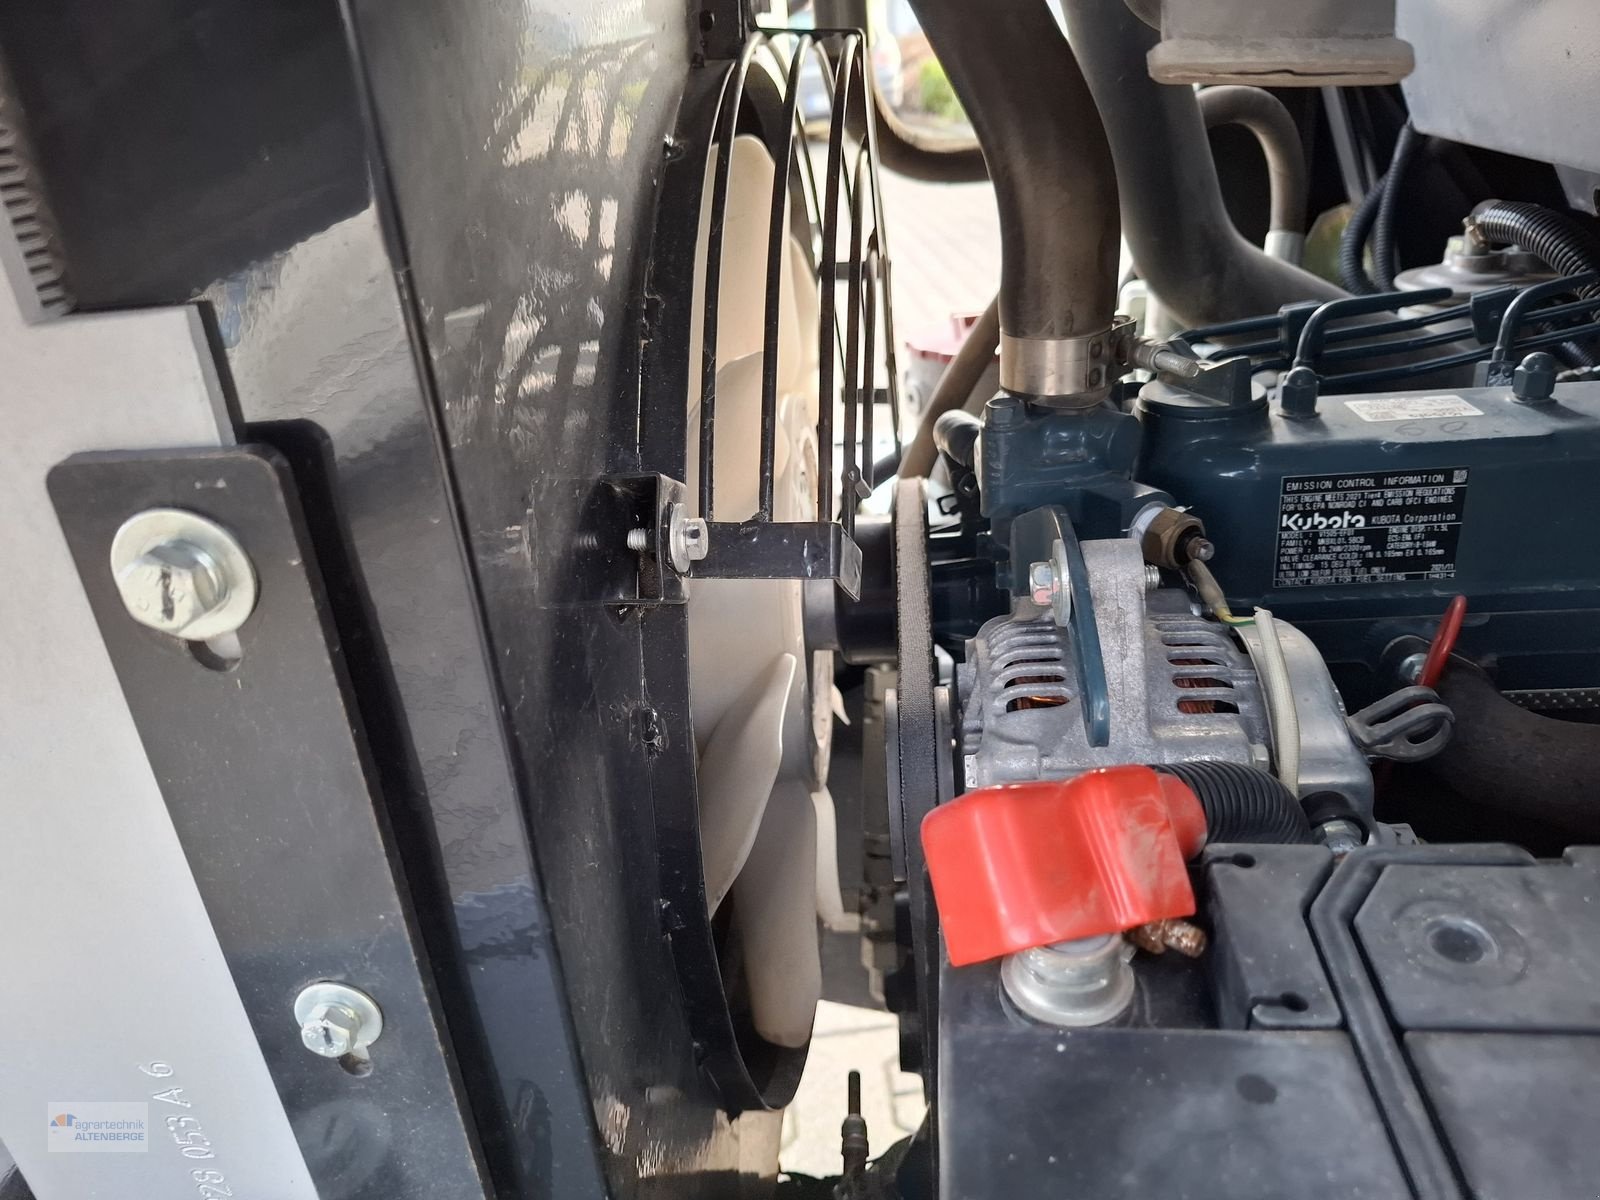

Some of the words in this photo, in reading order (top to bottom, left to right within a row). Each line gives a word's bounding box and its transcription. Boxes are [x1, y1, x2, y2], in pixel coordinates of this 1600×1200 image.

[1286, 480, 1332, 491] EMISSION
[1337, 478, 1376, 488] CONTROL
[1383, 474, 1445, 486] INFORMATION
[1283, 495, 1299, 503] THIS
[1300, 494, 1322, 502] ENGINE
[1325, 493, 1344, 501] MEETS
[1383, 490, 1413, 498] EMISSION
[1415, 488, 1455, 496] REGULATIONS
[1282, 511, 1365, 530] Kubota
[1371, 514, 1400, 524] KUBOTA
[1404, 512, 1456, 523] Corporation
[138, 1062, 174, 1078] 6
[152, 1087, 192, 1108] A
